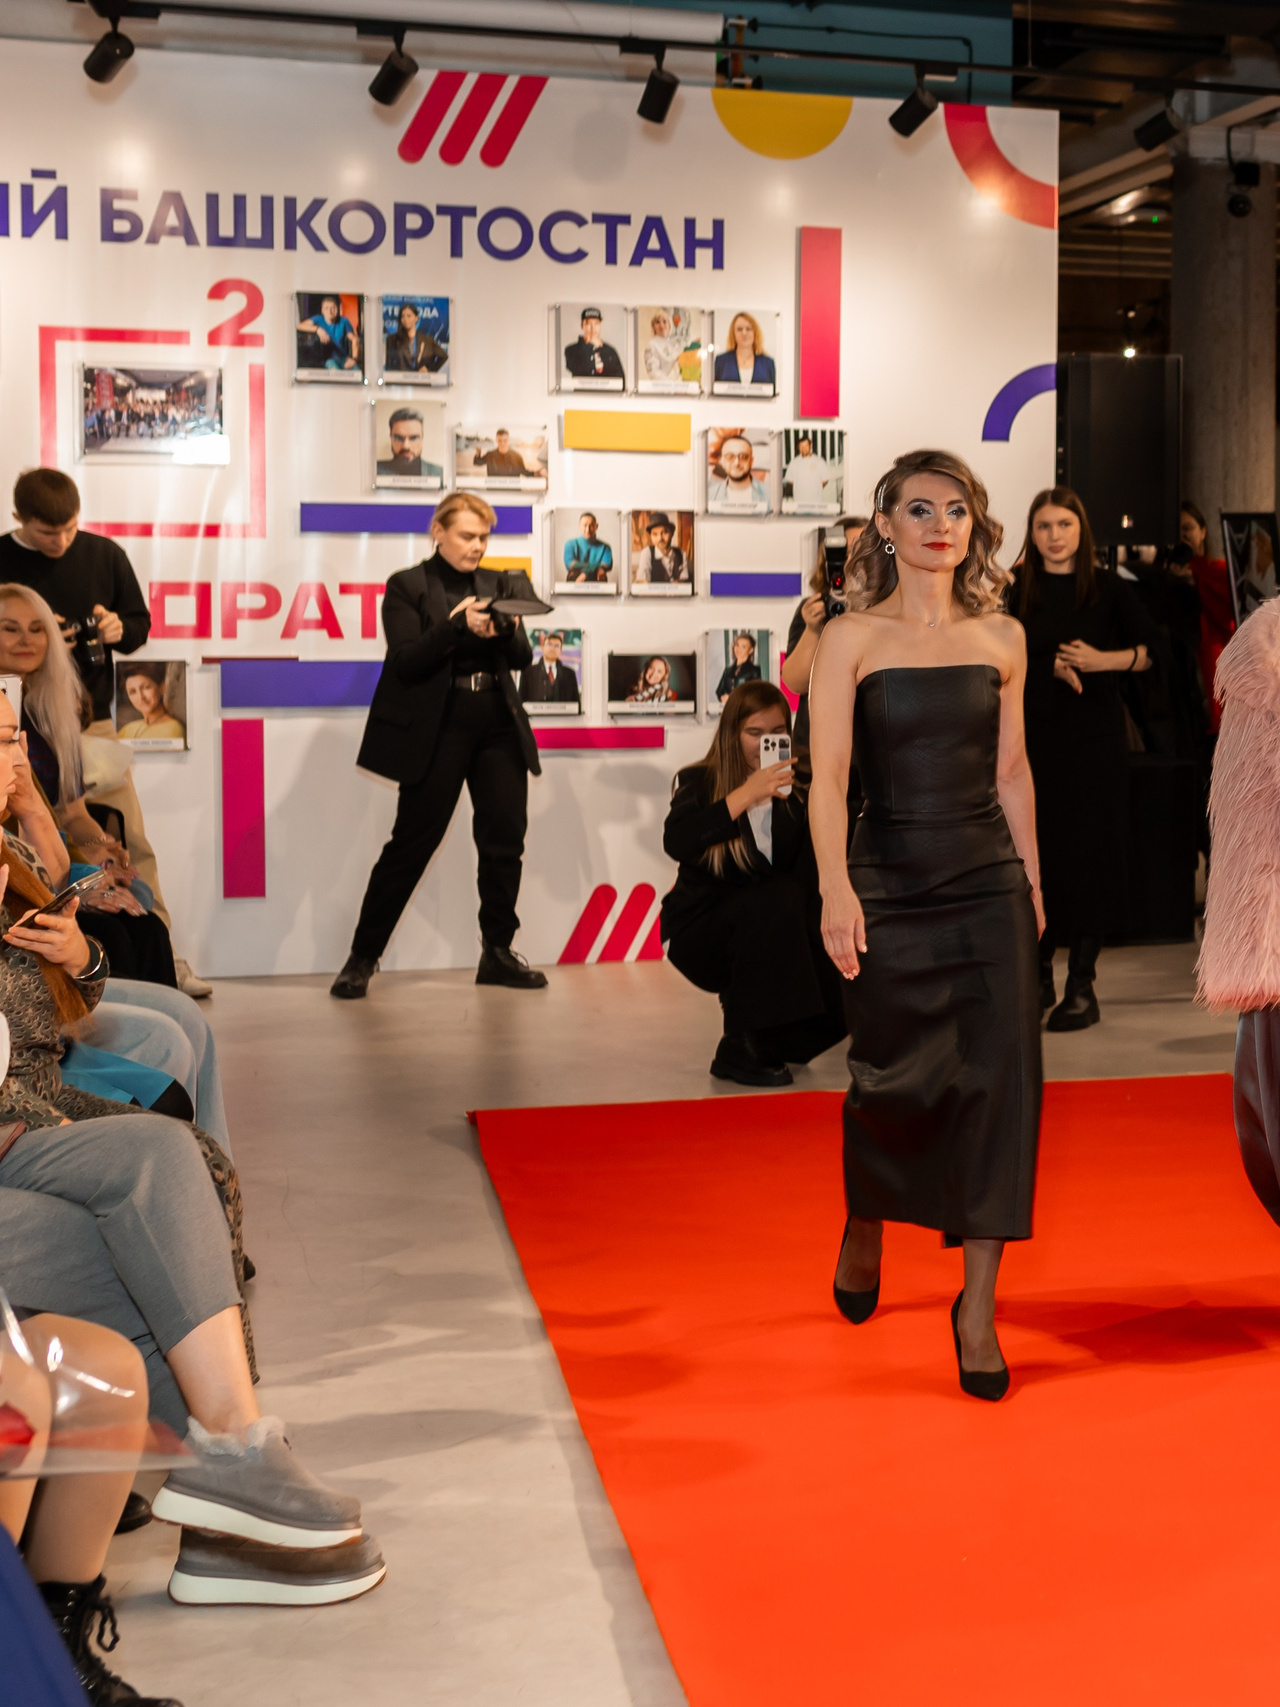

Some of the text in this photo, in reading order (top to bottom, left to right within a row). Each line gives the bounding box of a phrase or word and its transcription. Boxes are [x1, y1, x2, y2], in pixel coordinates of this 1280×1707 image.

[0, 168, 725, 271] Й БАШКОРТОСТАН
[207, 278, 264, 347] 2
